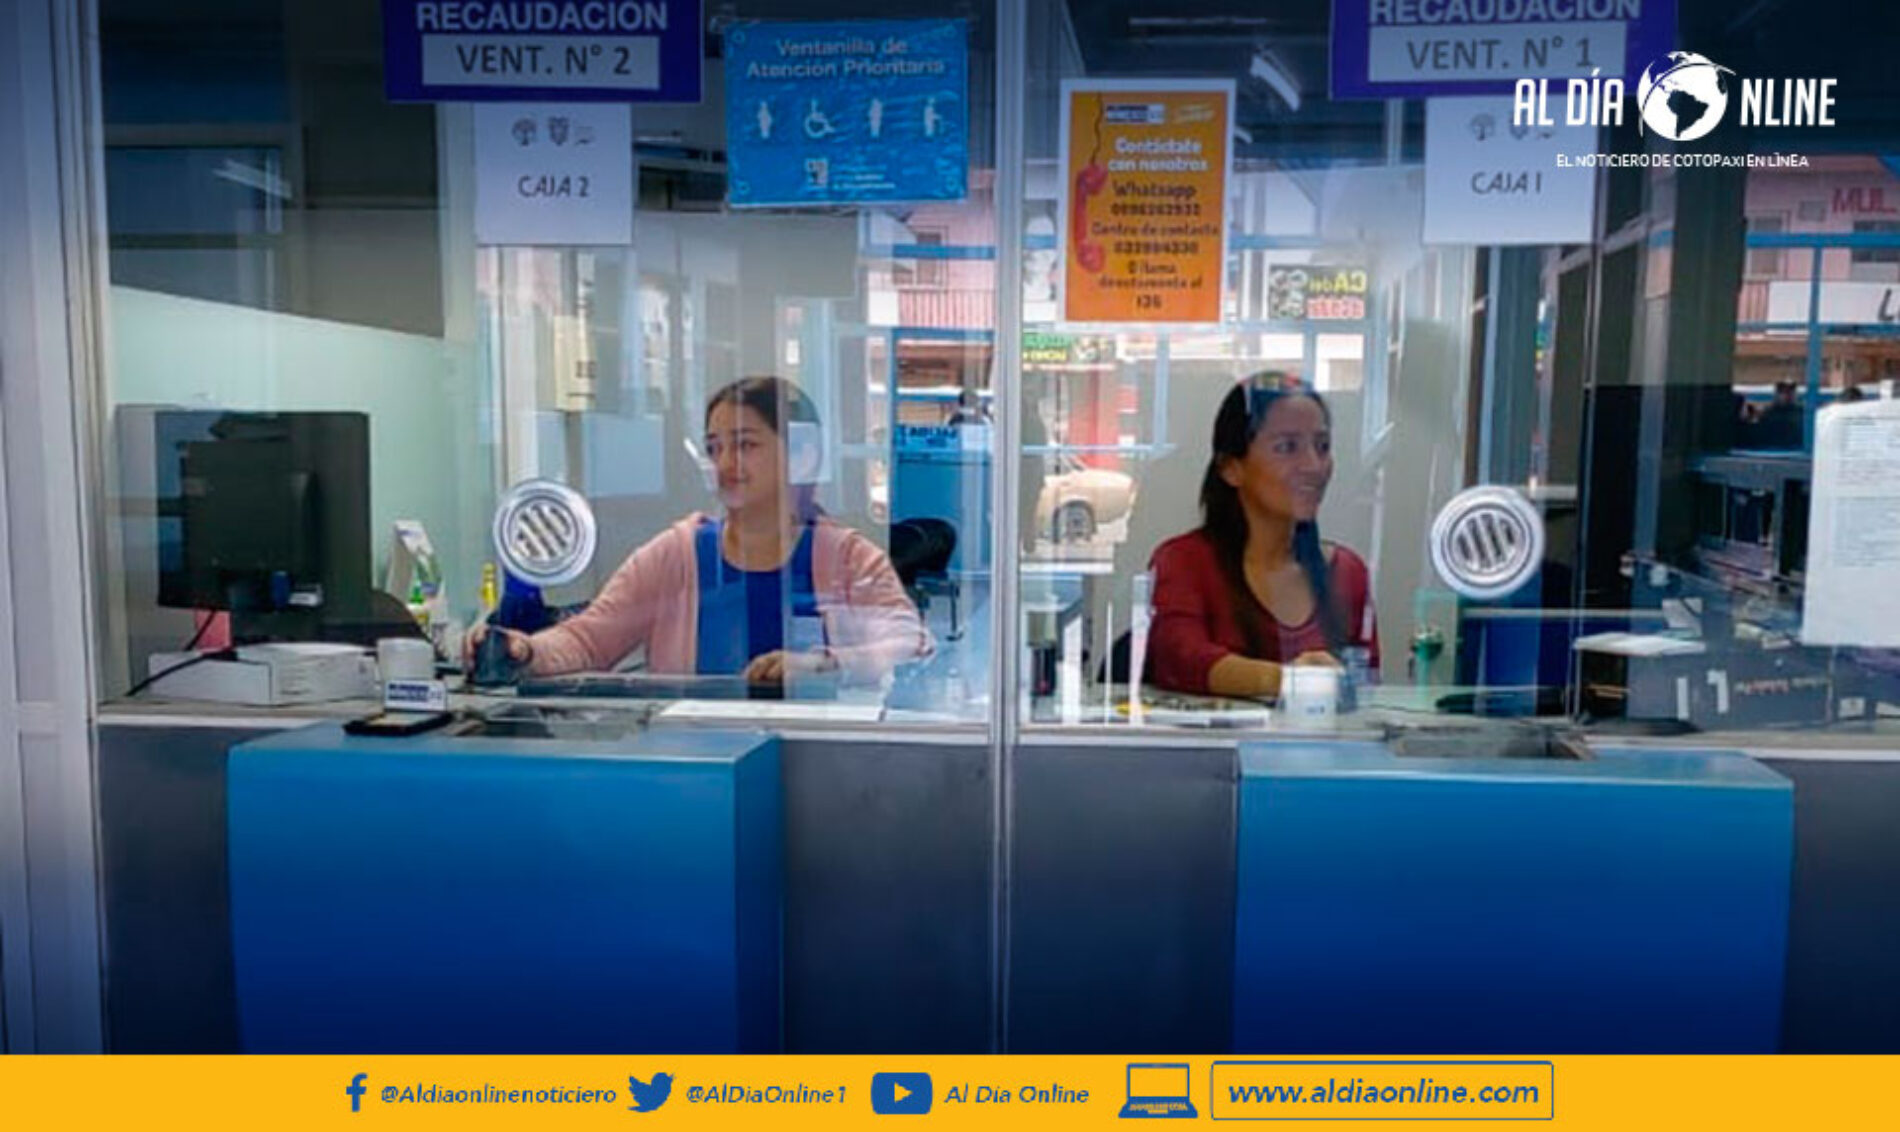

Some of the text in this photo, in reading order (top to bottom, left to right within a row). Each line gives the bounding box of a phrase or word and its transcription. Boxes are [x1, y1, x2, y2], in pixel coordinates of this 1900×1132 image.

[776, 36, 908, 57] Ventanilla de
[1407, 39, 1509, 71] VENT.
[1575, 37, 1594, 68] 1
[456, 44, 553, 75] VENT.
[613, 46, 632, 76] 2
[844, 57, 945, 76] Prioritaria
[1108, 157, 1208, 172] con nosotros
[517, 174, 591, 198] CAJA 2
[1471, 170, 1529, 195] CAJA
